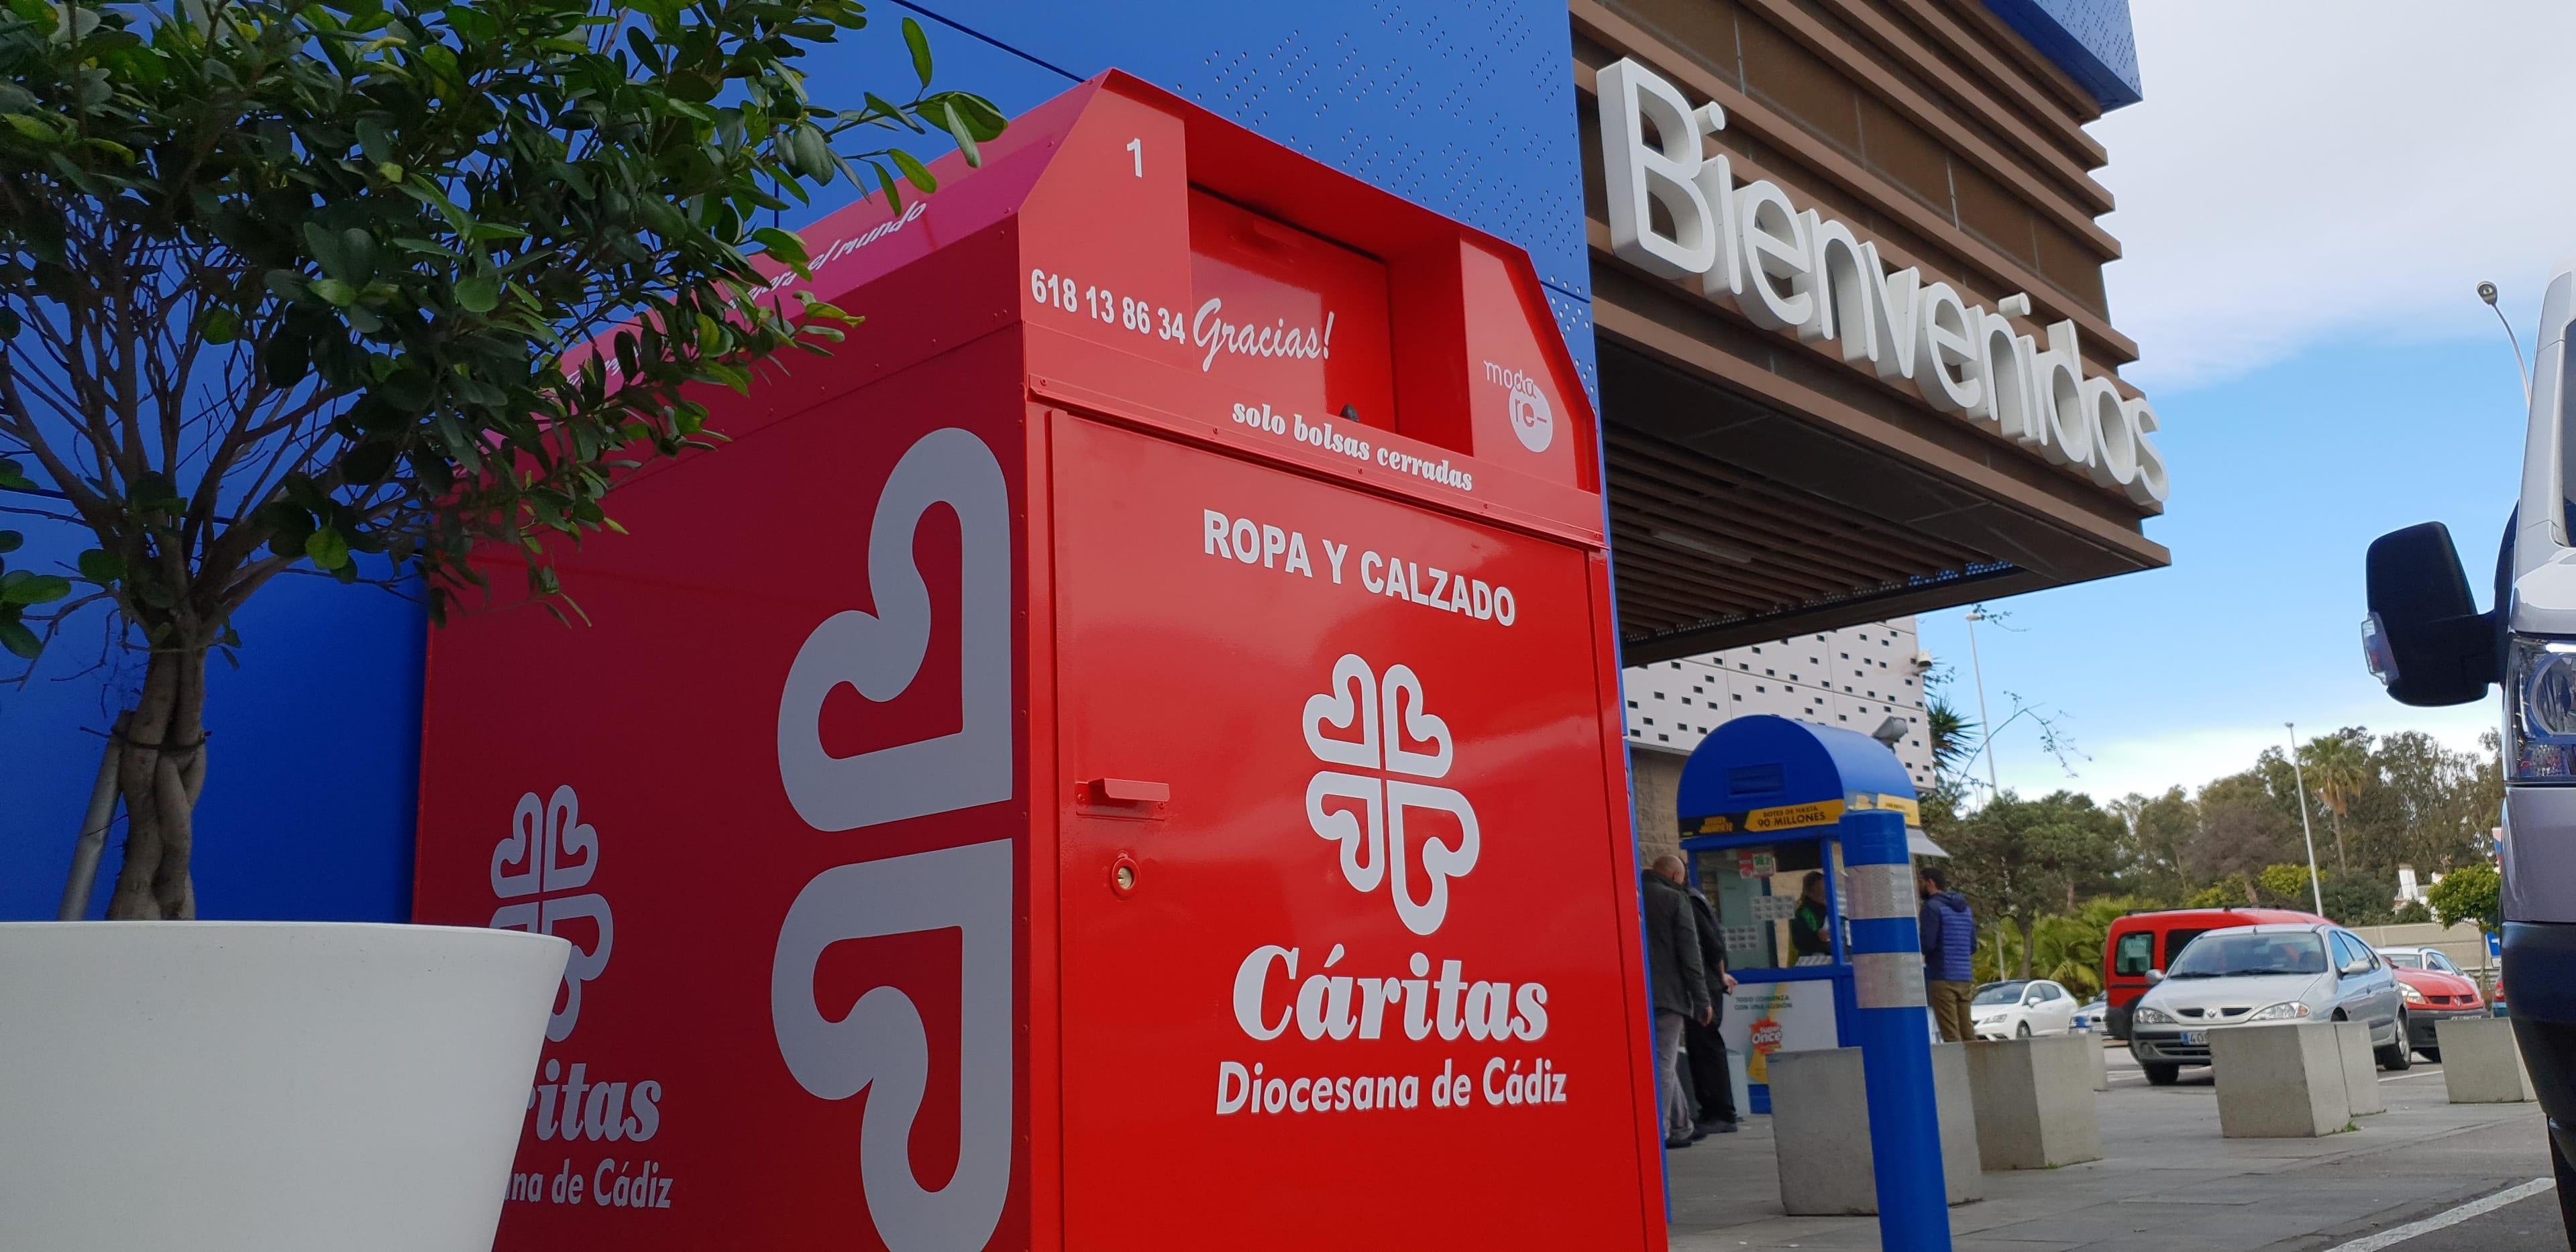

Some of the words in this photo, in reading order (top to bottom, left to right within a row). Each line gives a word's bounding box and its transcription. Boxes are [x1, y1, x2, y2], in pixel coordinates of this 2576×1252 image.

[1127, 137, 1142, 178] 1
[807, 239, 841, 271] el
[832, 200, 927, 262] mundo
[1031, 268, 1078, 313] 618
[1085, 285, 1115, 324] 13
[1122, 296, 1150, 335] 86
[1157, 307, 1186, 345] 34
[1597, 56, 2169, 504] Bienvenidos
[1193, 297, 1334, 373] Gracias!
[1483, 359, 1537, 399] moda
[1232, 402, 1285, 435] solo
[1293, 413, 1371, 461] bolsas
[1377, 446, 1472, 492] cerradas
[1203, 508, 1313, 578] ROPA
[1322, 538, 1348, 585] Y
[1360, 551, 1516, 627] CALZADO
[1758, 818, 1770, 827] 90
[1774, 811, 1826, 826] MILLONES
[1233, 943, 1548, 1041] Cáritas
[528, 1058, 662, 1142] itas
[1216, 1061, 1419, 1115] Diocesana
[1431, 1059, 1471, 1107] de
[1483, 1056, 1567, 1105] Cádiz
[551, 1158, 584, 1204] de
[594, 1158, 674, 1208] Cádiz
